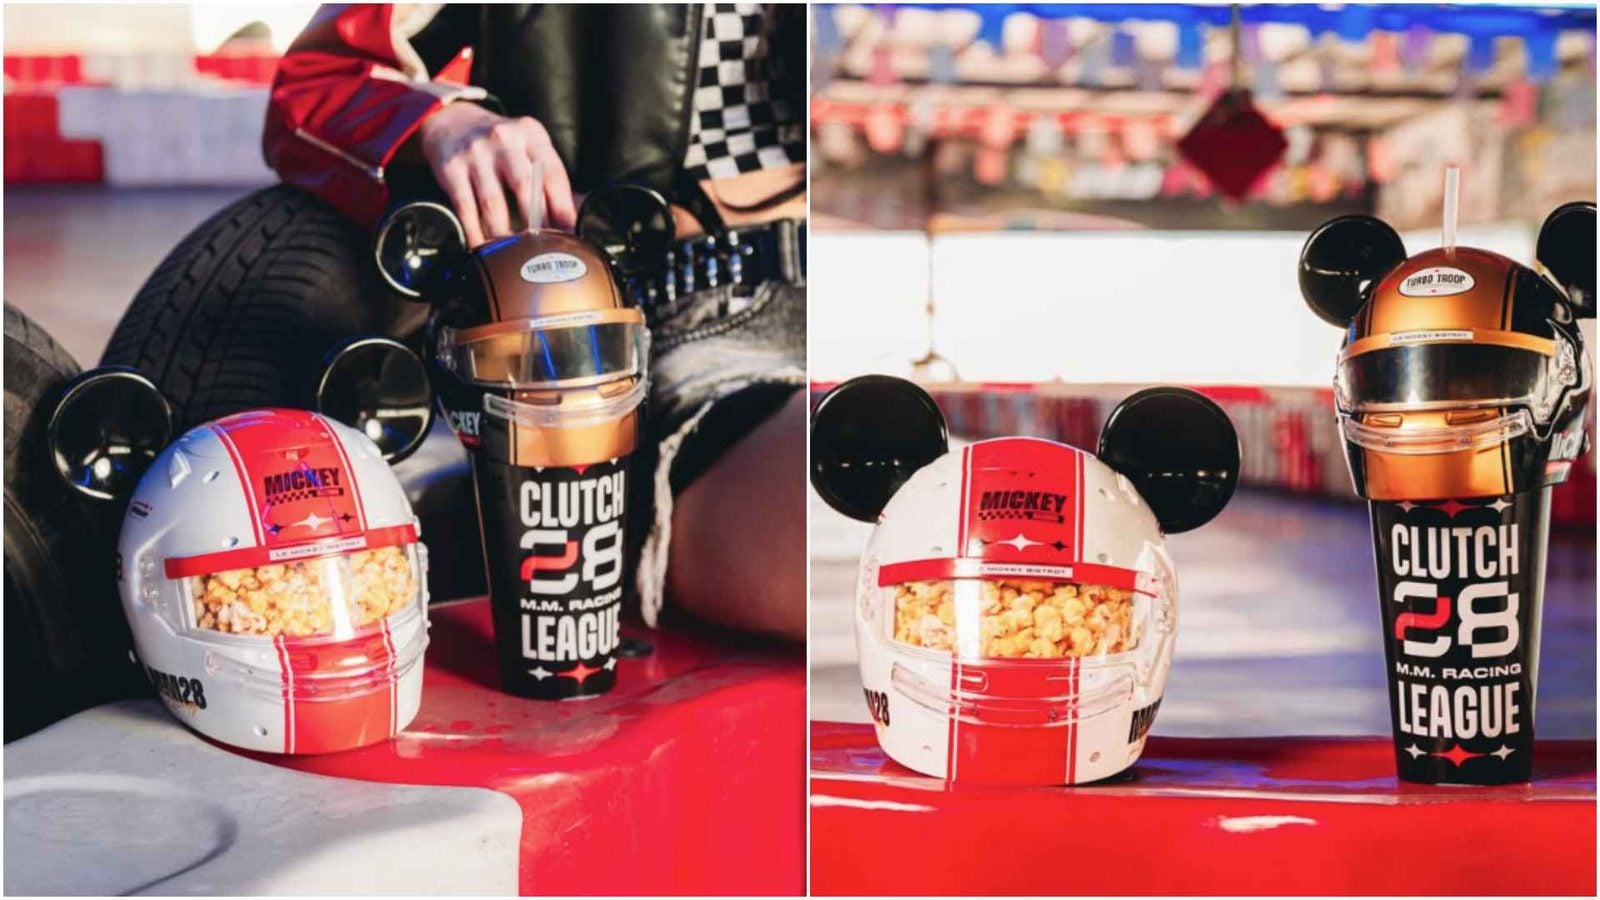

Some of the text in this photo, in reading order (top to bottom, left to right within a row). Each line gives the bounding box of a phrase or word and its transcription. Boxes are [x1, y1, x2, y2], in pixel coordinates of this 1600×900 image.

[1406, 275, 1433, 287] TURBO
[1438, 273, 1465, 284] TROOP
[264, 467, 339, 496] MICKEY
[520, 470, 625, 528] CLUTCH
[980, 490, 1067, 513] MICKEY
[520, 520, 624, 596] 28
[986, 566, 1022, 574] MICKEY
[1026, 568, 1067, 576] BISTROT
[1391, 523, 1519, 580] CLUTCH
[520, 587, 623, 612] M.M. RACING
[1393, 580, 1520, 659] 28
[521, 603, 621, 662] LEAGUE
[1396, 661, 1522, 680] M.M. RACING
[1398, 681, 1520, 740] LEAGUE
